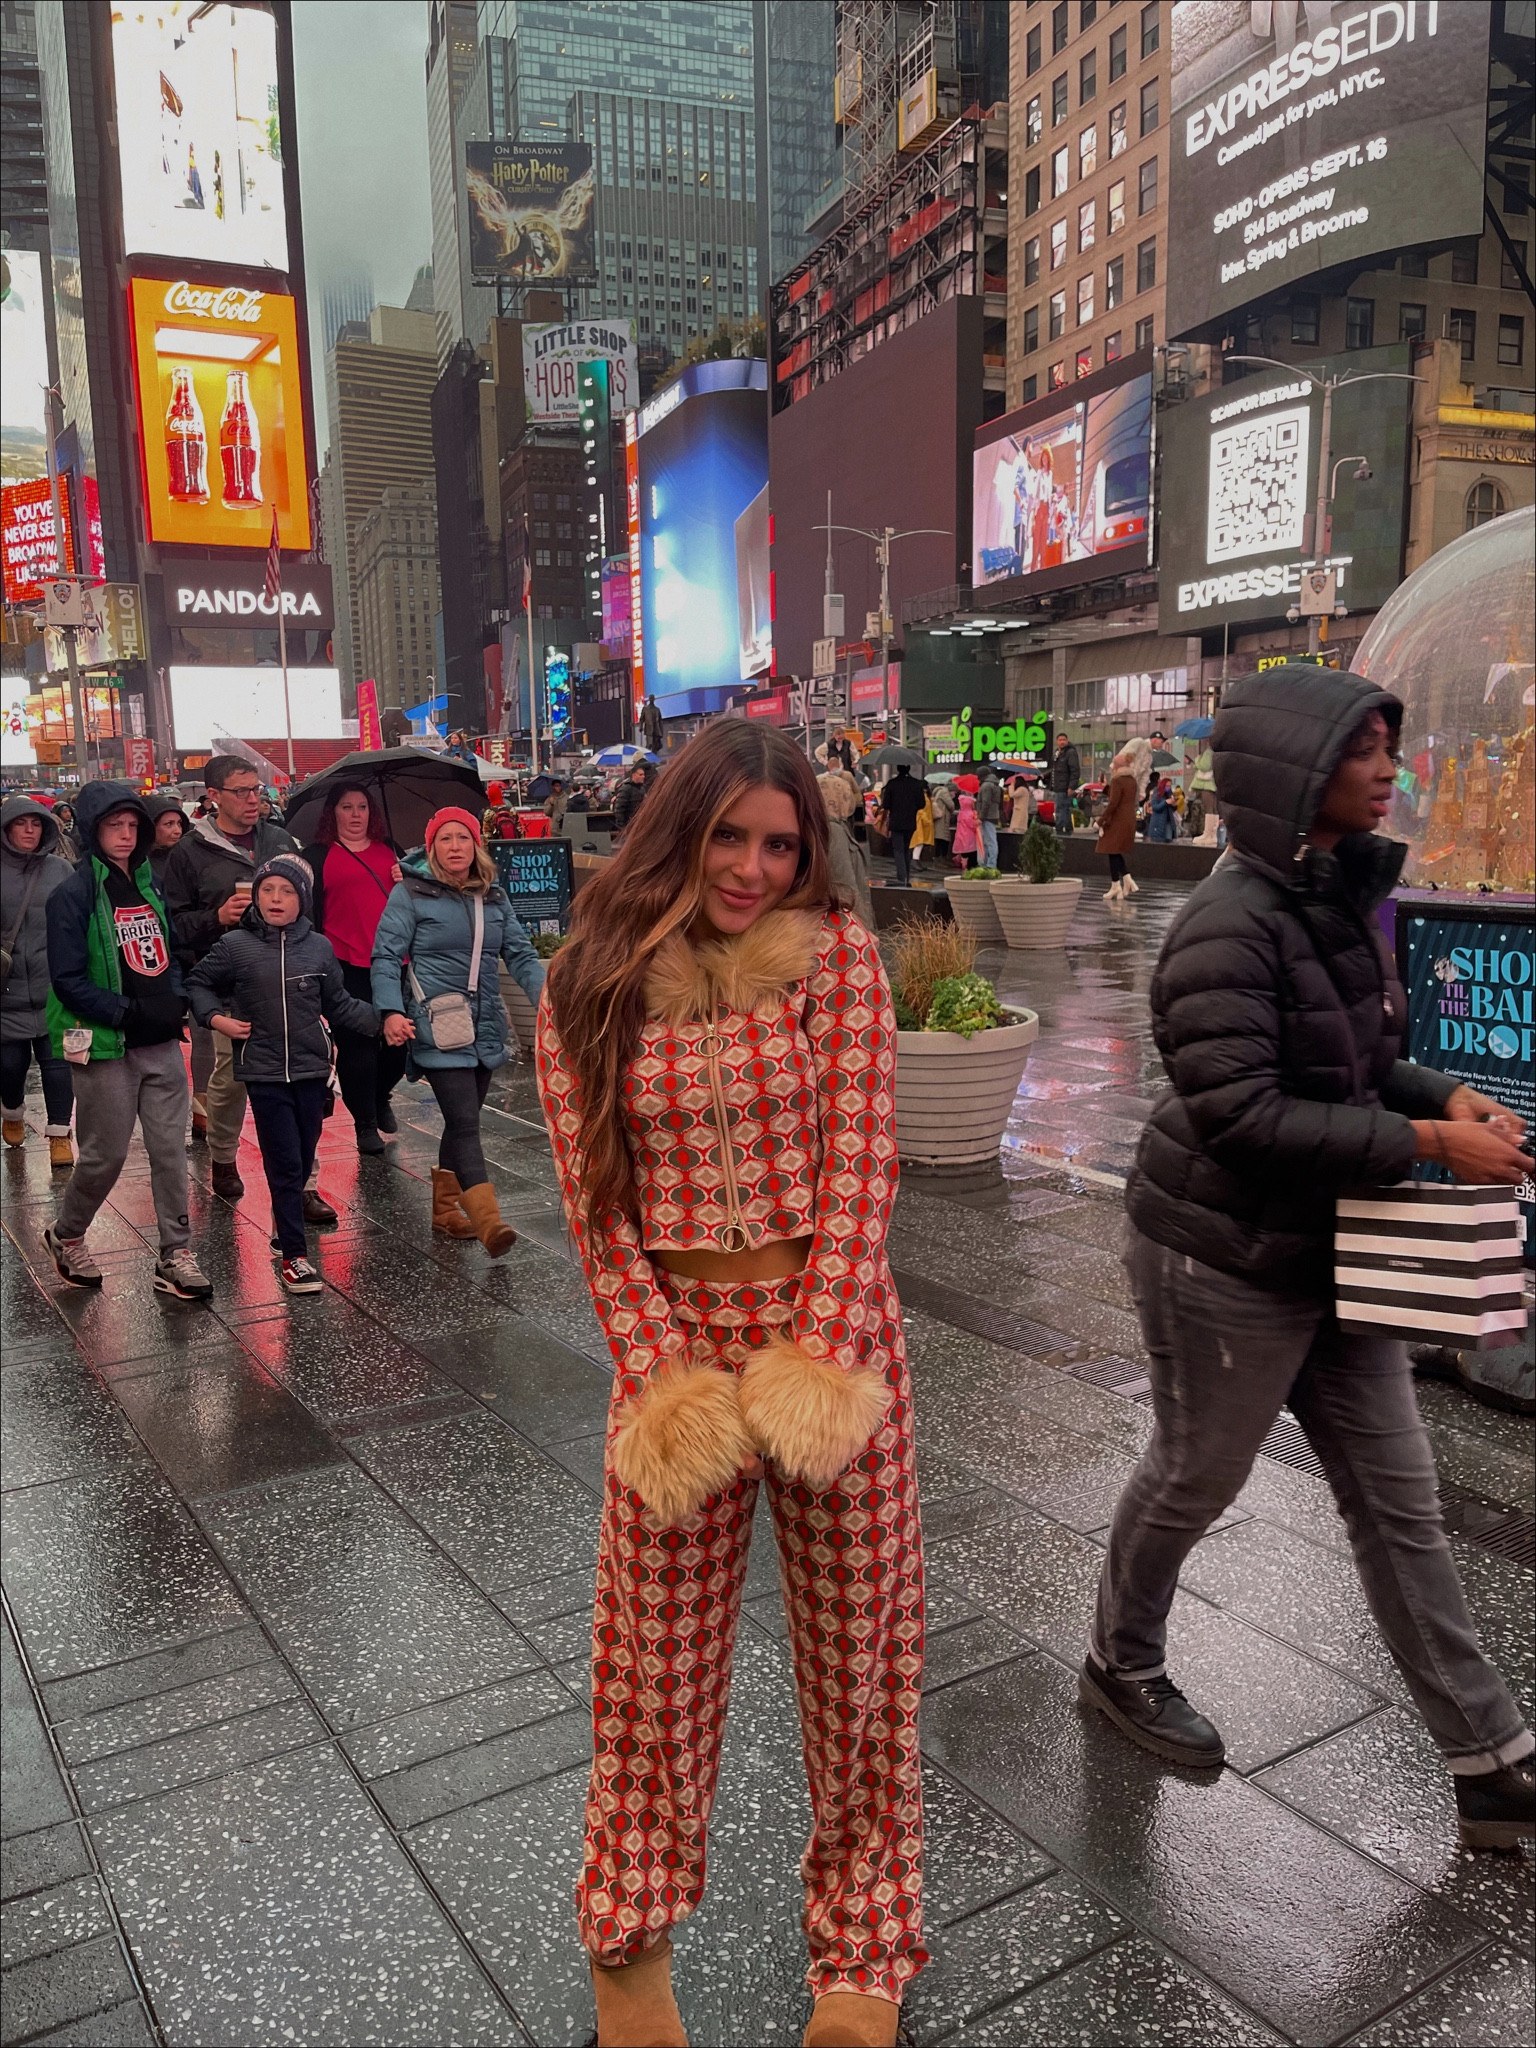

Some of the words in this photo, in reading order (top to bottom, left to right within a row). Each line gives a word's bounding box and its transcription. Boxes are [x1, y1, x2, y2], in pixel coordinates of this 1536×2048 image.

[1217, 126, 1263, 167] Curated
[1261, 113, 1285, 144] just
[1286, 103, 1306, 126] for
[1306, 88, 1338, 118] you,
[1340, 67, 1386, 99] NYC.
[490, 161, 529, 188] Harry
[529, 159, 569, 189] Potter
[1213, 196, 1252, 235] SOHO
[1259, 167, 1309, 208] OPENS
[1310, 145, 1363, 182] SEPT.
[1366, 137, 1388, 162] 16
[1244, 217, 1266, 244] 514
[1266, 188, 1336, 234] Broadway
[1247, 237, 1287, 271] Spring
[1288, 228, 1299, 250] &
[1301, 206, 1369, 244] Broome
[164, 281, 264, 323] Coca-Cola
[534, 325, 586, 359] LITTLE
[589, 326, 627, 355] SHOP
[573, 349, 584, 357] OF
[1259, 380, 1312, 407] DETAILS
[1457, 442, 1483, 458] THE
[13, 500, 54, 523] YOU'VE
[5, 522, 40, 545] NEVER
[630, 532, 642, 571] FREE
[589, 514, 603, 617] JUSTIN
[178, 588, 322, 616] PANDORA
[118, 588, 139, 657] HELLO!
[631, 574, 644, 668] CHOCOLATE
[103, 676, 114, 688] 46
[973, 710, 1048, 761] pelé
[131, 742, 149, 774] tkts
[937, 754, 965, 764] SOCCER
[989, 751, 1037, 761] SOCCER
[511, 854, 552, 868] SHOP
[521, 866, 559, 880] BALL
[509, 879, 559, 894] DROPS
[1450, 946, 1535, 987] SHO
[1443, 982, 1469, 1000] TIL
[1438, 999, 1469, 1017] THE
[1473, 1072, 1487, 1081] New
[1487, 1074, 1502, 1083] York
[1502, 1076, 1520, 1086] City's
[1482, 1084, 1510, 1095] shopping
[1499, 1095, 1519, 1105] Times
